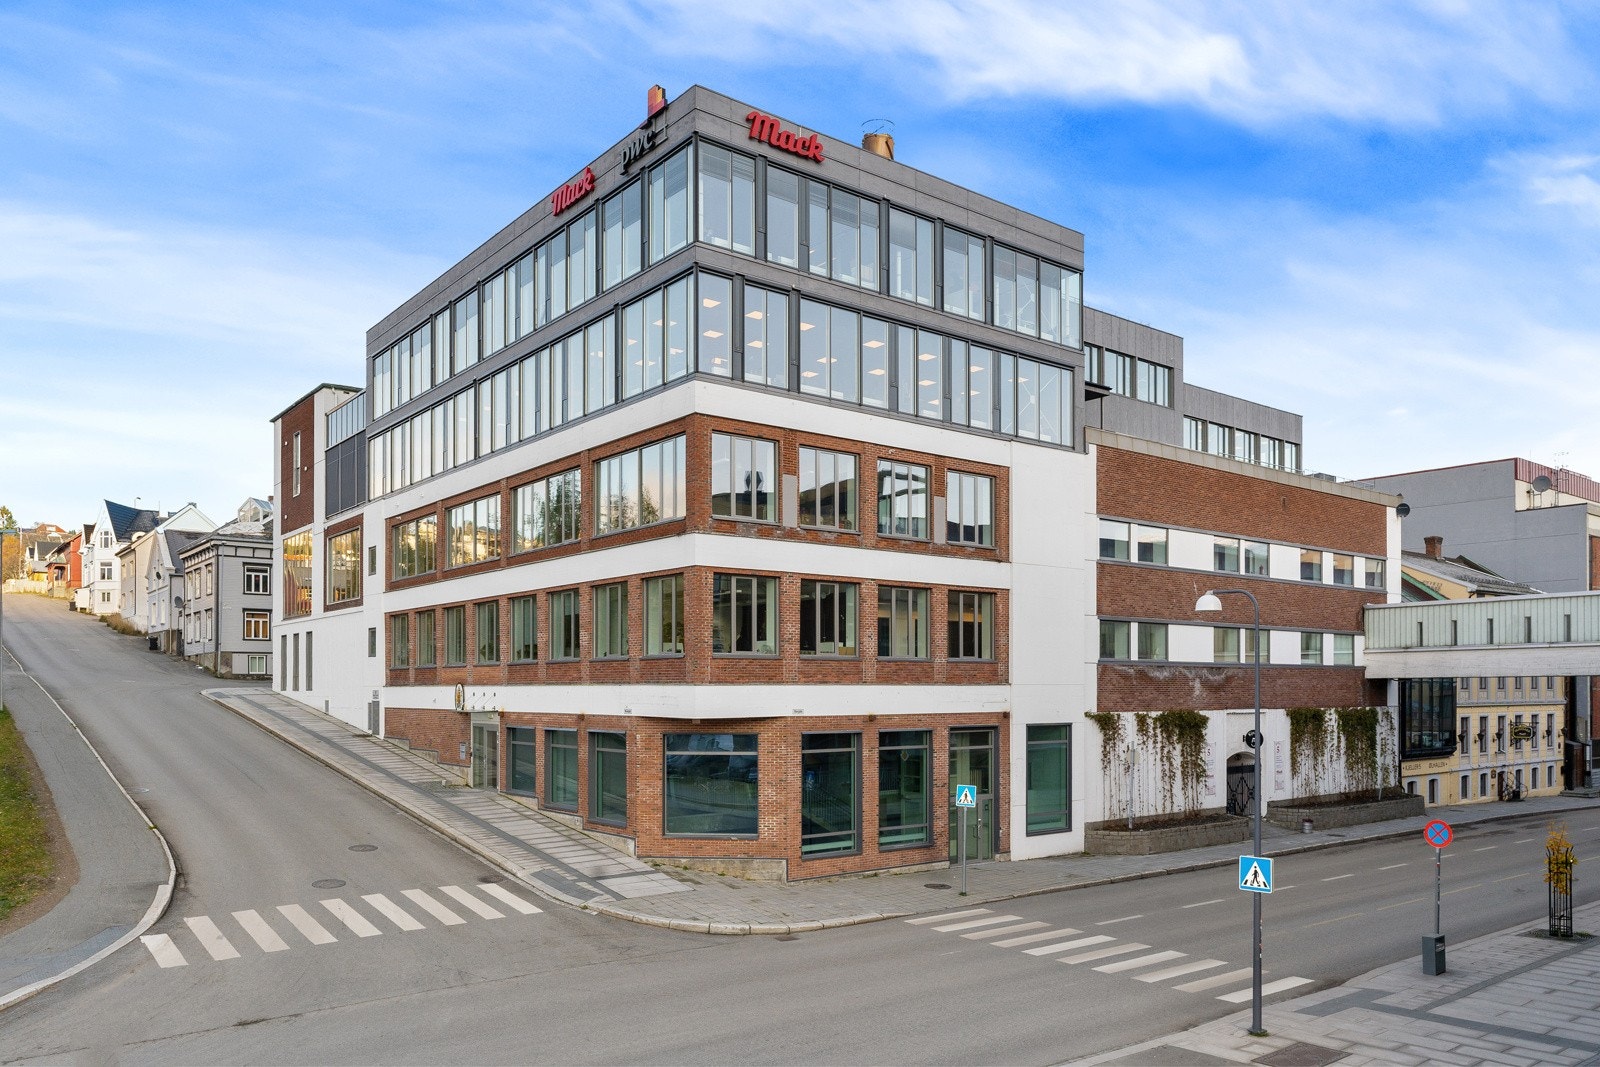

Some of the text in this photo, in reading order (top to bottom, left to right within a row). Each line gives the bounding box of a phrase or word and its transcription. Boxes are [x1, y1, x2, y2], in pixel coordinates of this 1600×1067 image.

[619, 130, 655, 175] pwc
[745, 111, 826, 163] Mack
[551, 166, 595, 216] Mack
